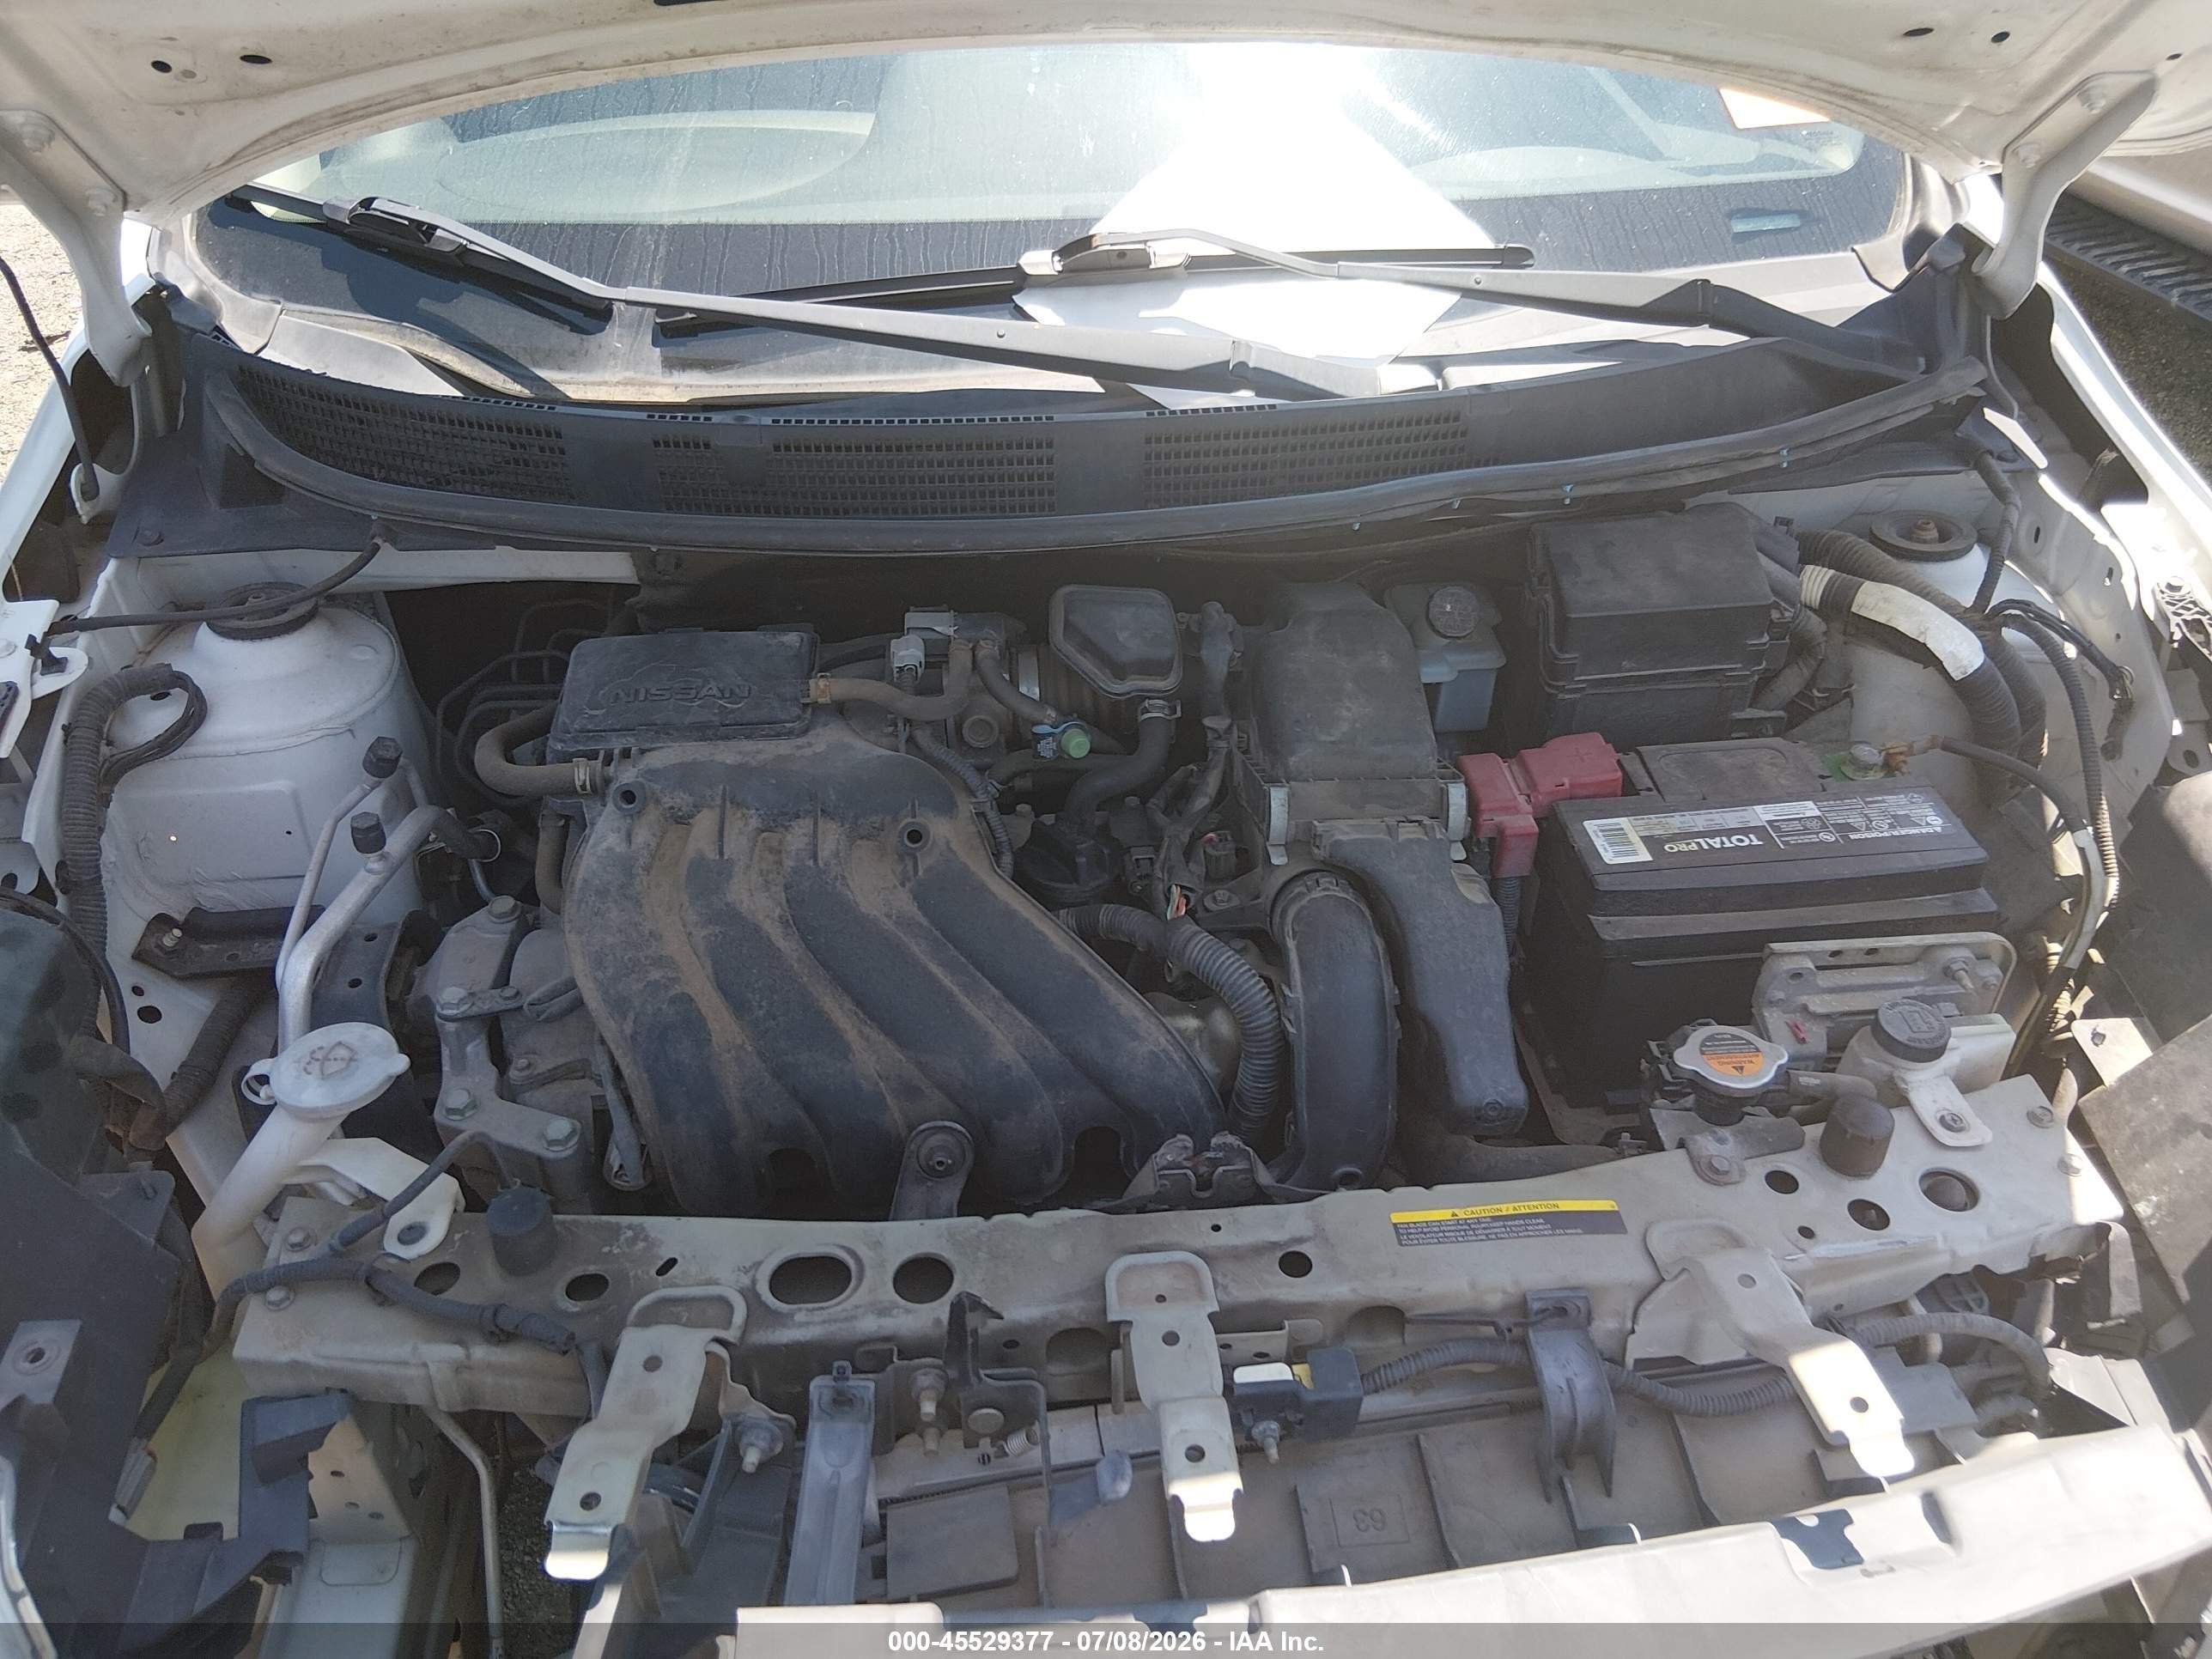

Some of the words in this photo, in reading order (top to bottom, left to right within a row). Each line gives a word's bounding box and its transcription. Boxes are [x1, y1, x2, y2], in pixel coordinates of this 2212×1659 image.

[608, 684, 753, 705] NISSAN
[1463, 1206, 1503, 1216] CAUTION
[1511, 1202, 1560, 1212] ATTENTION
